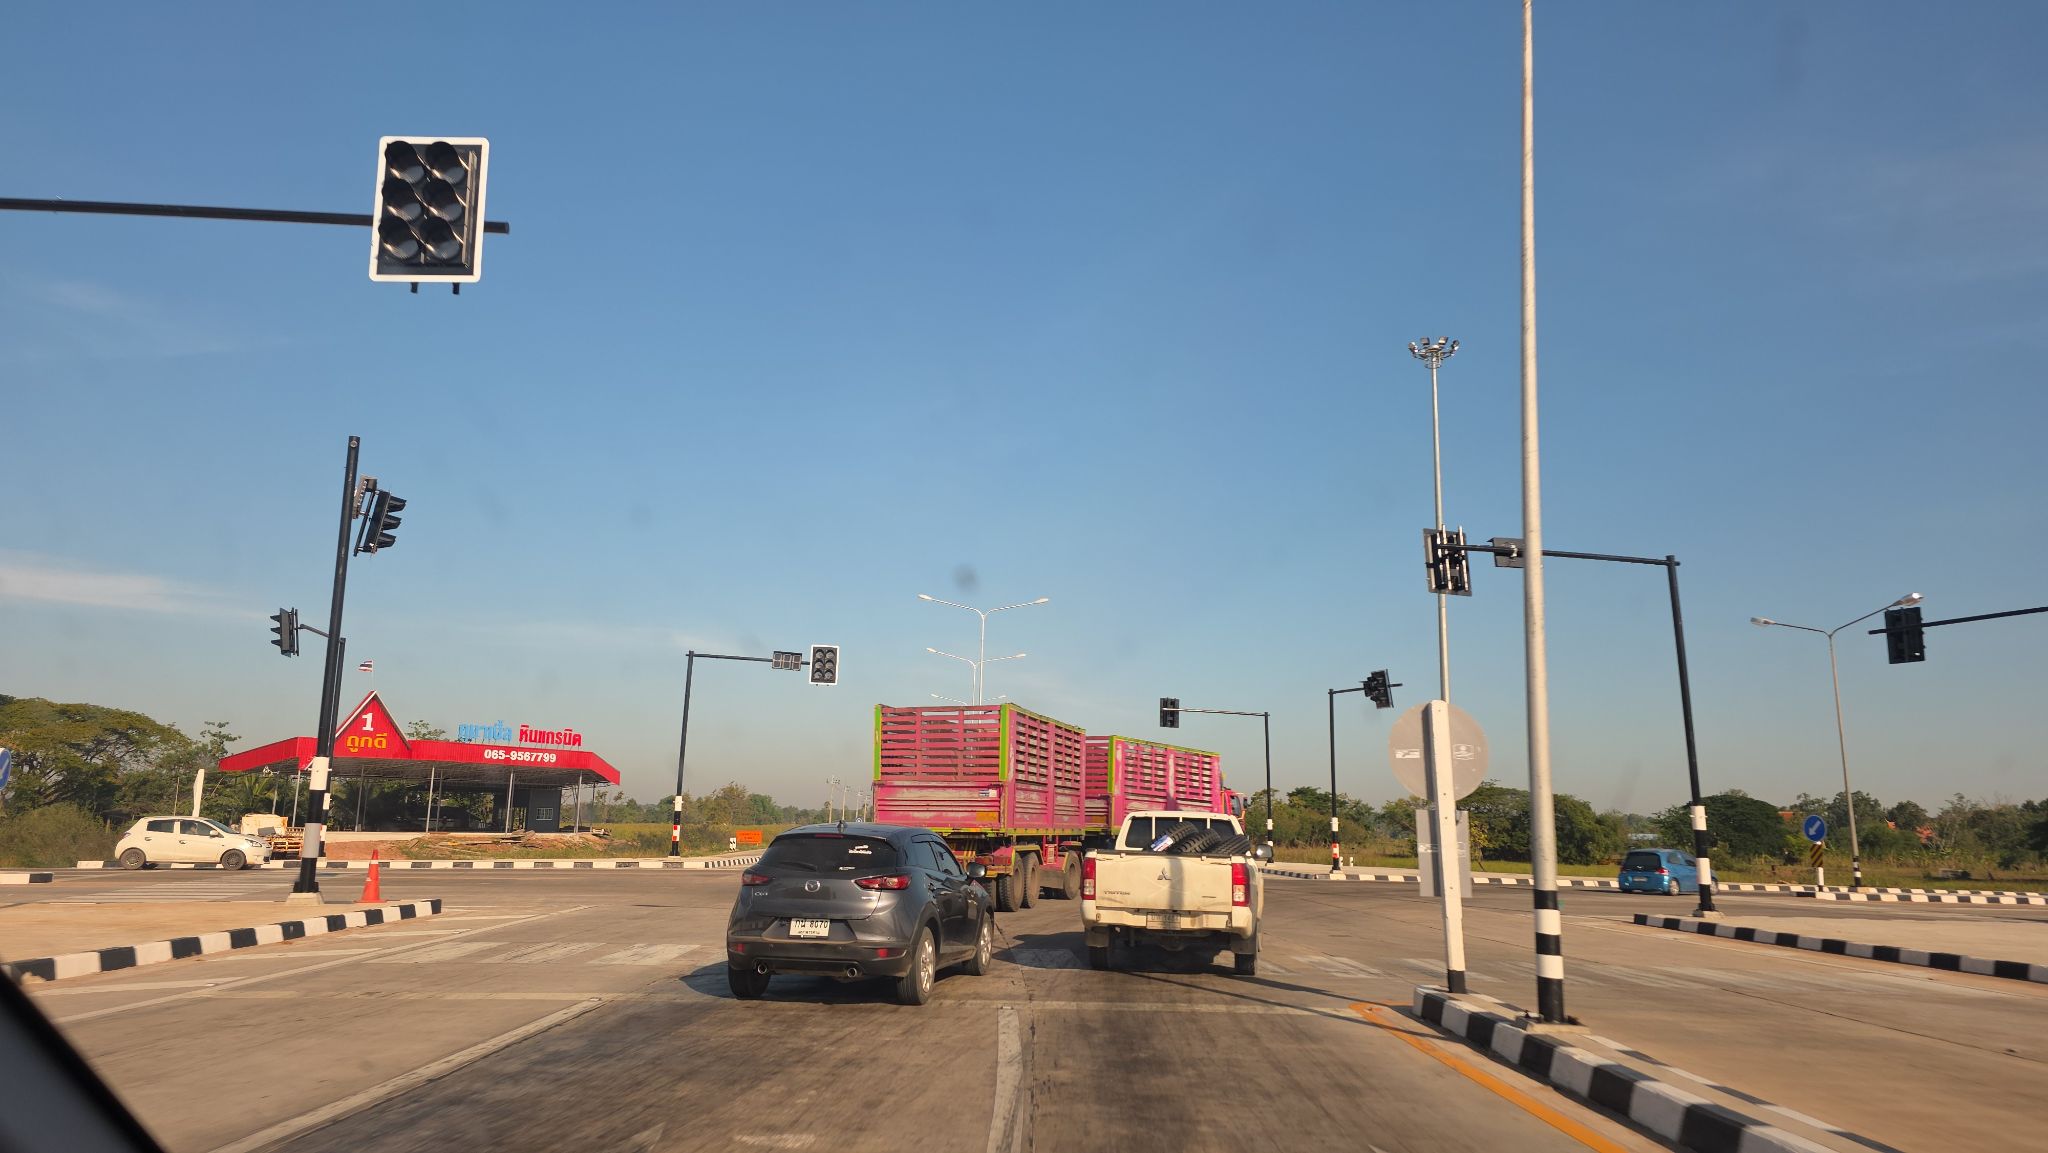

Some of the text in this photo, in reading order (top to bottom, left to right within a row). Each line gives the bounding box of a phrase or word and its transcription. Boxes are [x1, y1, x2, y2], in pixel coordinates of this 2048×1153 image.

[362, 712, 374, 731] 1
[346, 732, 388, 753] ถูกดี
[484, 749, 557, 763] 065-9567799
